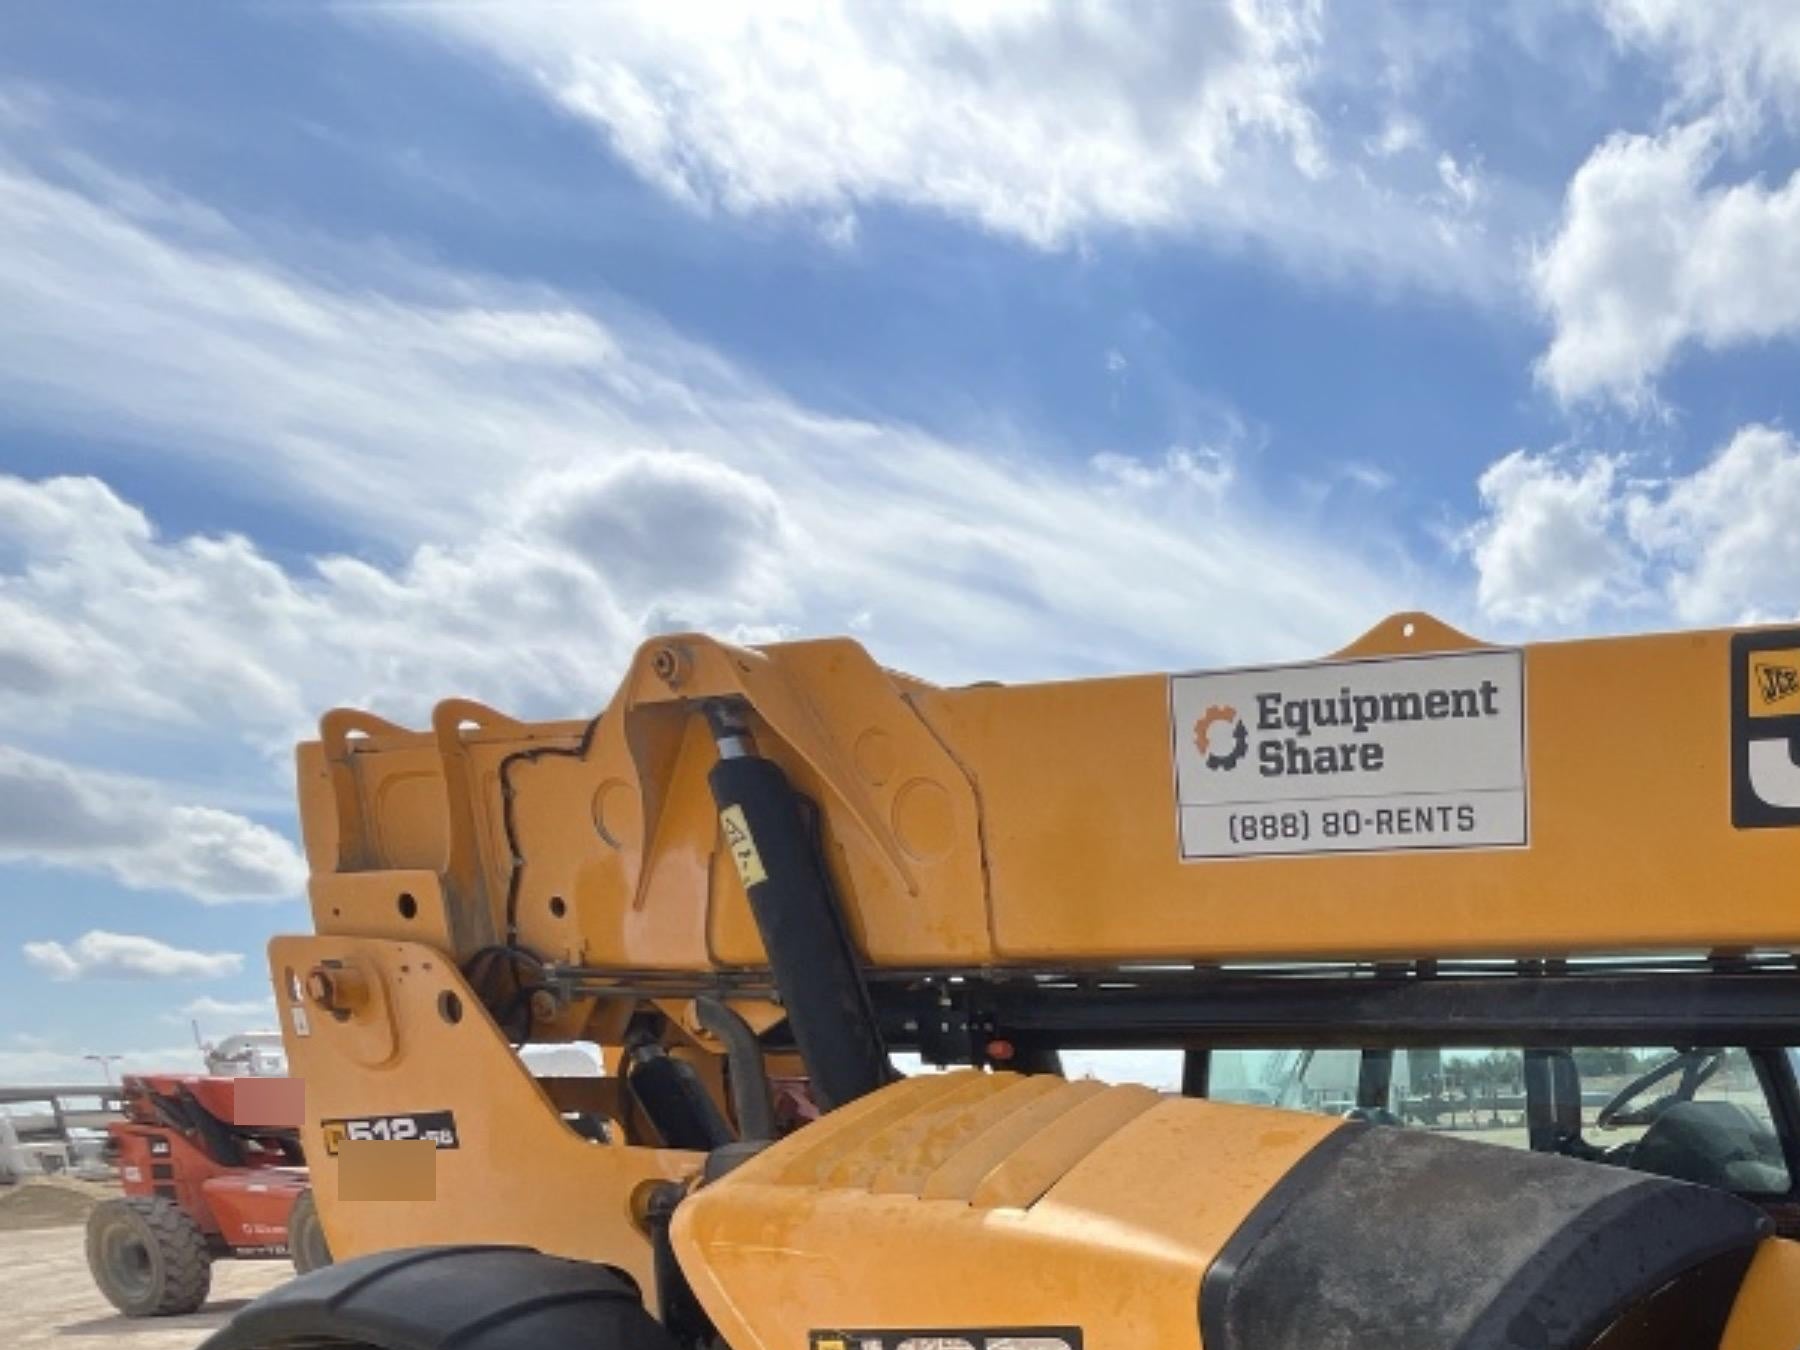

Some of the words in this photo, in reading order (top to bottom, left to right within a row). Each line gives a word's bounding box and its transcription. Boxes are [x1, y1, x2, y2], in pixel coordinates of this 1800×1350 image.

[1256, 680, 1498, 737] Equipment
[1258, 739, 1384, 777] Share
[1229, 810, 1310, 843] (888)
[1322, 805, 1474, 837] 80-RENTS
